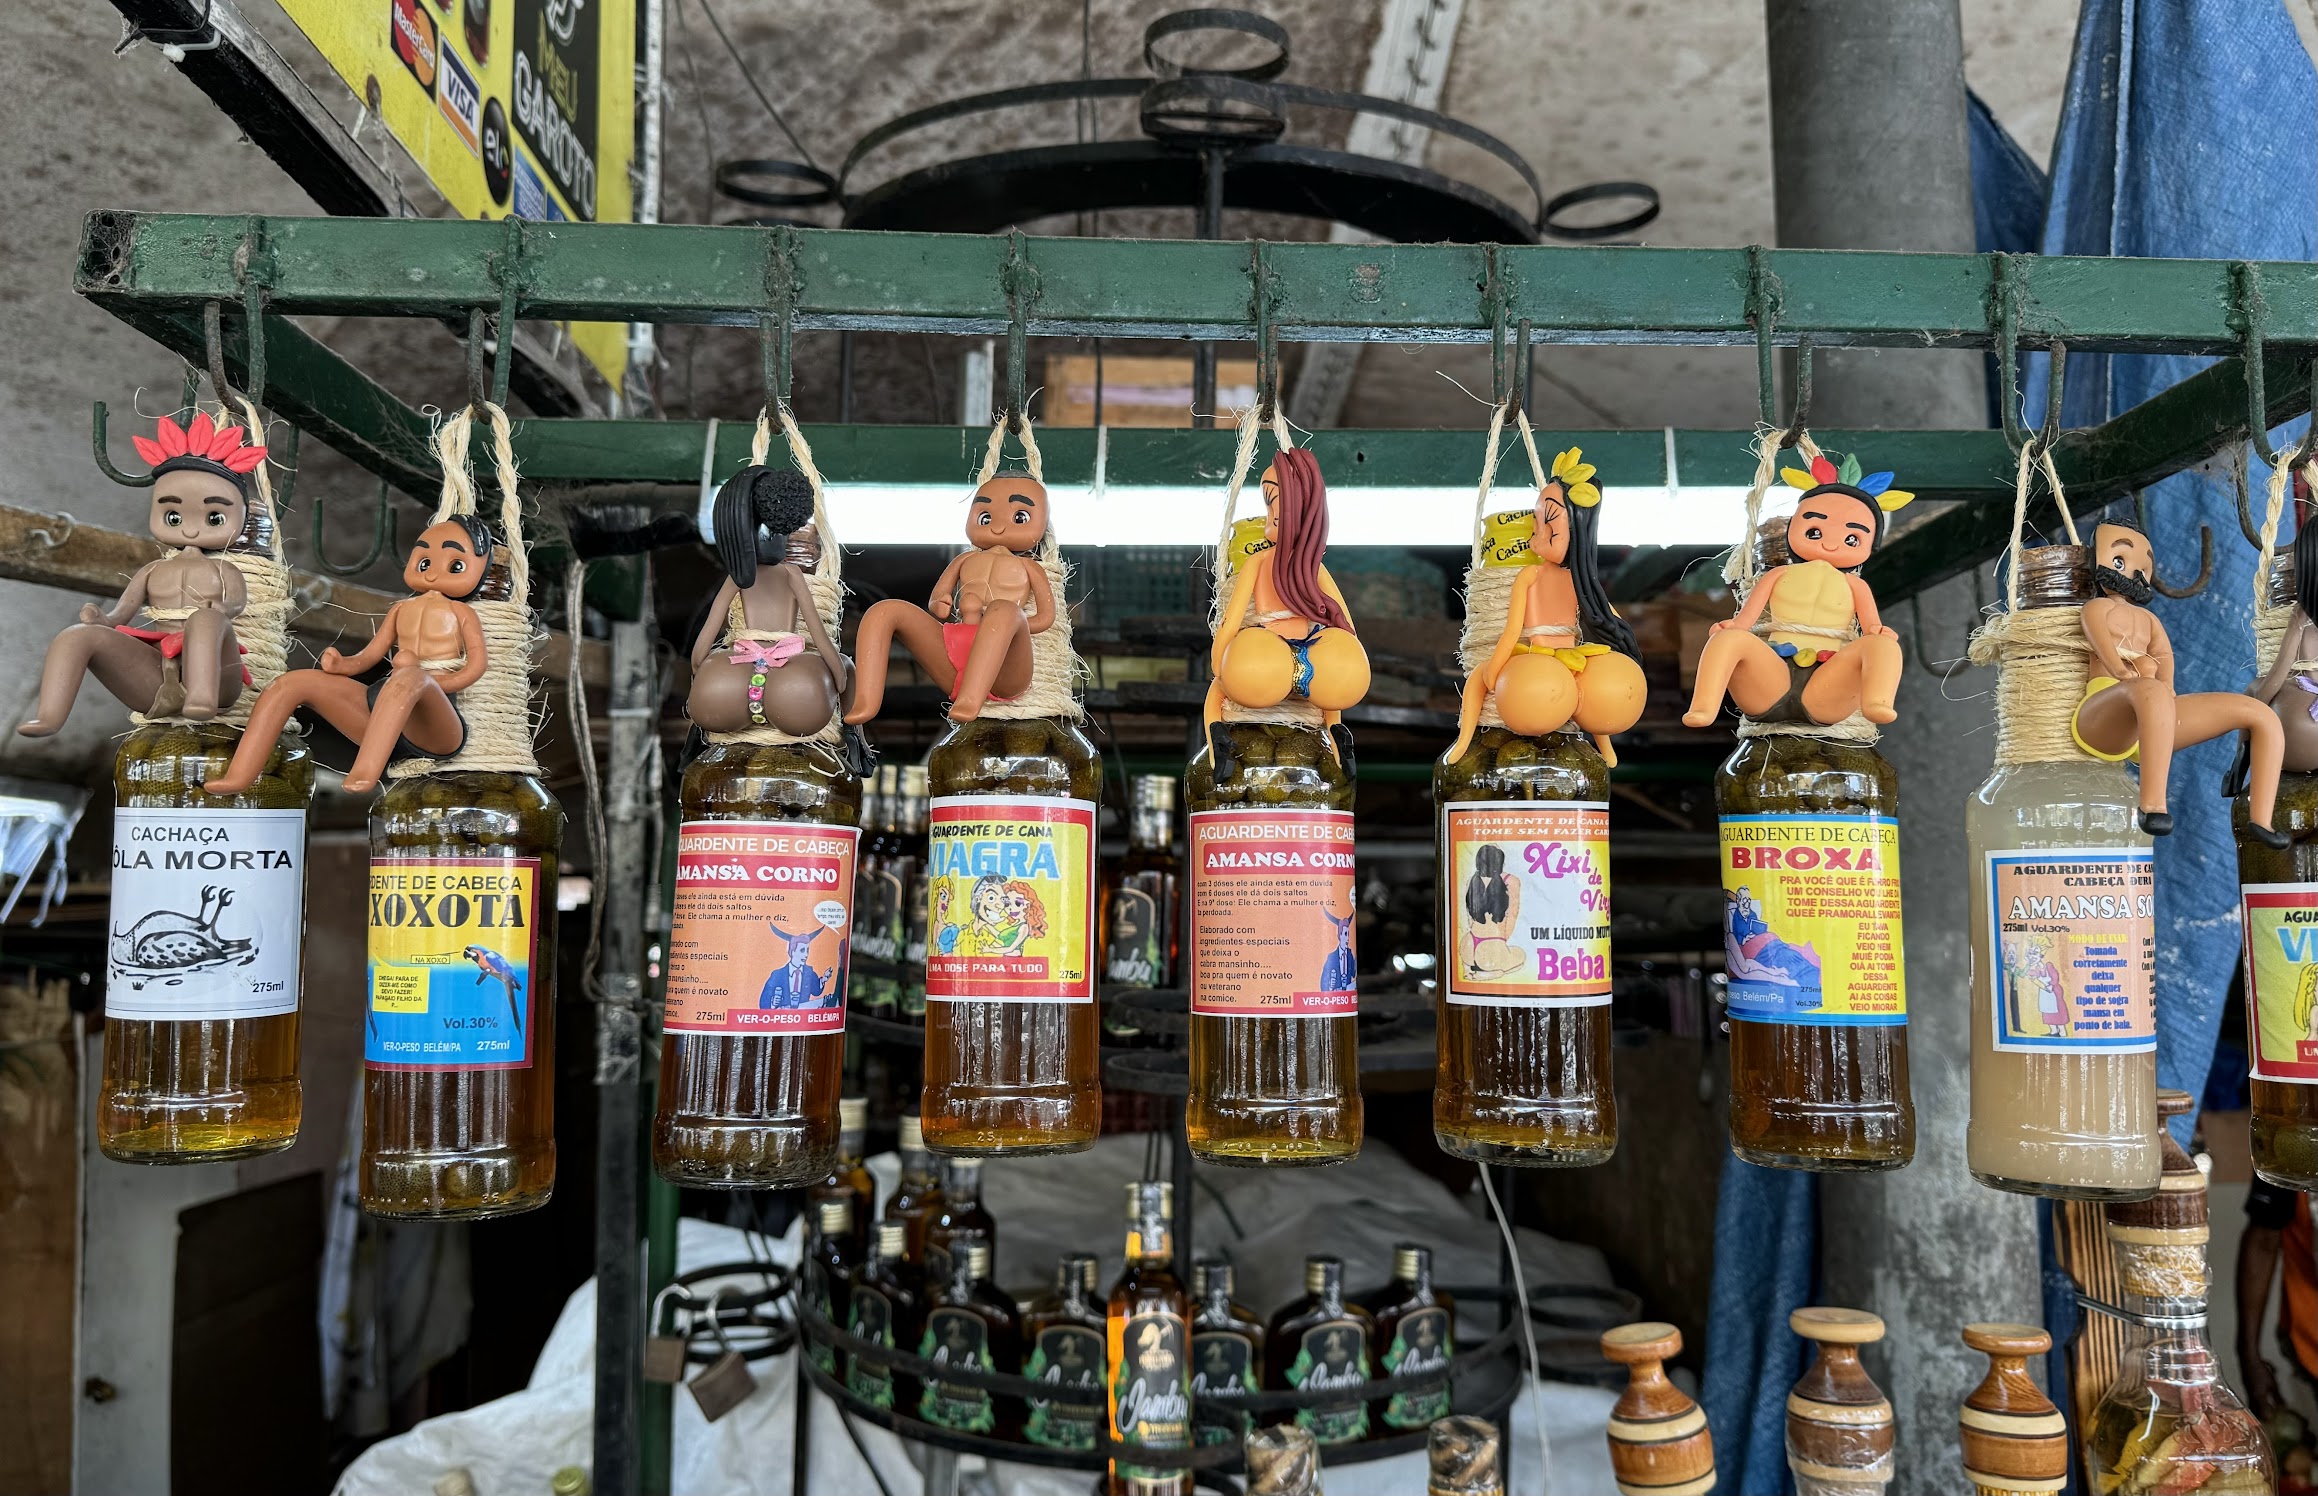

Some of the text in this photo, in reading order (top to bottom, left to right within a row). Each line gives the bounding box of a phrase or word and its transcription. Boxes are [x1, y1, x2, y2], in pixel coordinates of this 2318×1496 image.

[447, 67, 475, 128] VISA
[514, 49, 597, 220] GAROTO
[1456, 817, 1554, 826] AGUARDENTE
[1557, 817, 1576, 826] DE
[1580, 817, 1605, 827] CANA
[131, 826, 230, 846] CACHAÇA
[995, 824, 1015, 837] DE
[1018, 825, 1054, 838] CANA
[1199, 825, 1310, 841] AGUARDENTE
[1313, 825, 1333, 840] DE
[1474, 827, 1592, 836] TOME SEM FAZER
[1721, 827, 1897, 847] AGUARDENTE DE CABEÇA
[763, 838, 789, 853] DE
[794, 839, 850, 859] CABEÇA
[165, 850, 293, 870] MORTA
[1206, 851, 1305, 868] AMANSA
[1523, 842, 1592, 879] Xixi
[1731, 846, 1882, 871] BROXA
[756, 865, 838, 884] CORNO
[2013, 864, 2123, 876] AGUARDENTE
[1588, 867, 1603, 886] de
[1779, 875, 1865, 886] PRA VOCÊ QUE É
[370, 875, 523, 893] DENTE DE CABEÇA
[1275, 879, 1293, 887] está
[2064, 877, 2125, 888] CABEÇA
[1787, 886, 1803, 896] UM
[1806, 887, 1862, 897] CONSELHO
[718, 893, 737, 901] está
[754, 893, 785, 902] dúvida
[1238, 899, 1251, 907] Ele
[1253, 899, 1281, 907] chama
[1290, 899, 1318, 907] mulher
[1787, 897, 1818, 907] TOME
[1820, 898, 1855, 908] DESSA
[370, 893, 525, 928] XOXOTA
[725, 903, 752, 911] saltos
[2009, 895, 2133, 920] AMANSA
[698, 912, 723, 920] chama
[732, 913, 764, 921] mulher
[1199, 926, 1234, 934] Elaborado
[1858, 922, 1870, 931] EU
[2003, 923, 2028, 933] 275ml
[1530, 924, 1594, 941] UM LÍQUIDO
[1857, 932, 1890, 941] FICANDO
[1200, 937, 1290, 947] ingredientes especiais
[2068, 934, 2094, 944] MODO
[1856, 942, 1876, 951] VEIO
[2084, 946, 2118, 956] Tomada
[690, 952, 729, 961] especiais
[1200, 949, 1211, 958] que
[1211, 948, 1232, 957] deixa
[1874, 952, 1894, 961] PODIA
[944, 963, 969, 973] DOSE
[972, 963, 1007, 973] PARA
[1011, 963, 1044, 973] TUDO
[1537, 948, 1605, 981] Beba
[2073, 958, 2128, 968] corretamente
[1059, 970, 1082, 980] 275ml
[1212, 970, 1293, 981] pra quem é novato
[1863, 972, 1889, 981] DESSA
[2091, 970, 2115, 981] deixa
[252, 980, 284, 993] 275ml
[698, 987, 729, 996] novato
[1208, 983, 1242, 991] veterano
[1847, 982, 1898, 991] AGUARDENTE
[2084, 983, 2122, 994] qualquer
[1259, 995, 1292, 1005] 275ml
[1302, 996, 1349, 1006] VER-O-PESO
[1743, 990, 1784, 1004] Belém/Pa
[1860, 992, 1872, 1001] AS
[1873, 992, 1897, 1001] COISAS
[2075, 995, 2129, 1006] tipo de sogra
[1849, 1002, 1871, 1011] VEIO
[696, 1011, 726, 1022] 275ml
[736, 1013, 801, 1024] VER-O-PESO
[2083, 1008, 2125, 1018] mansa em
[443, 1016, 498, 1030] Vol.30%
[2074, 1020, 2100, 1031] ponto
[2101, 1020, 2112, 1030] de
[383, 1039, 510, 1053] VER-O-PESO BELÉM/PA 275ml
